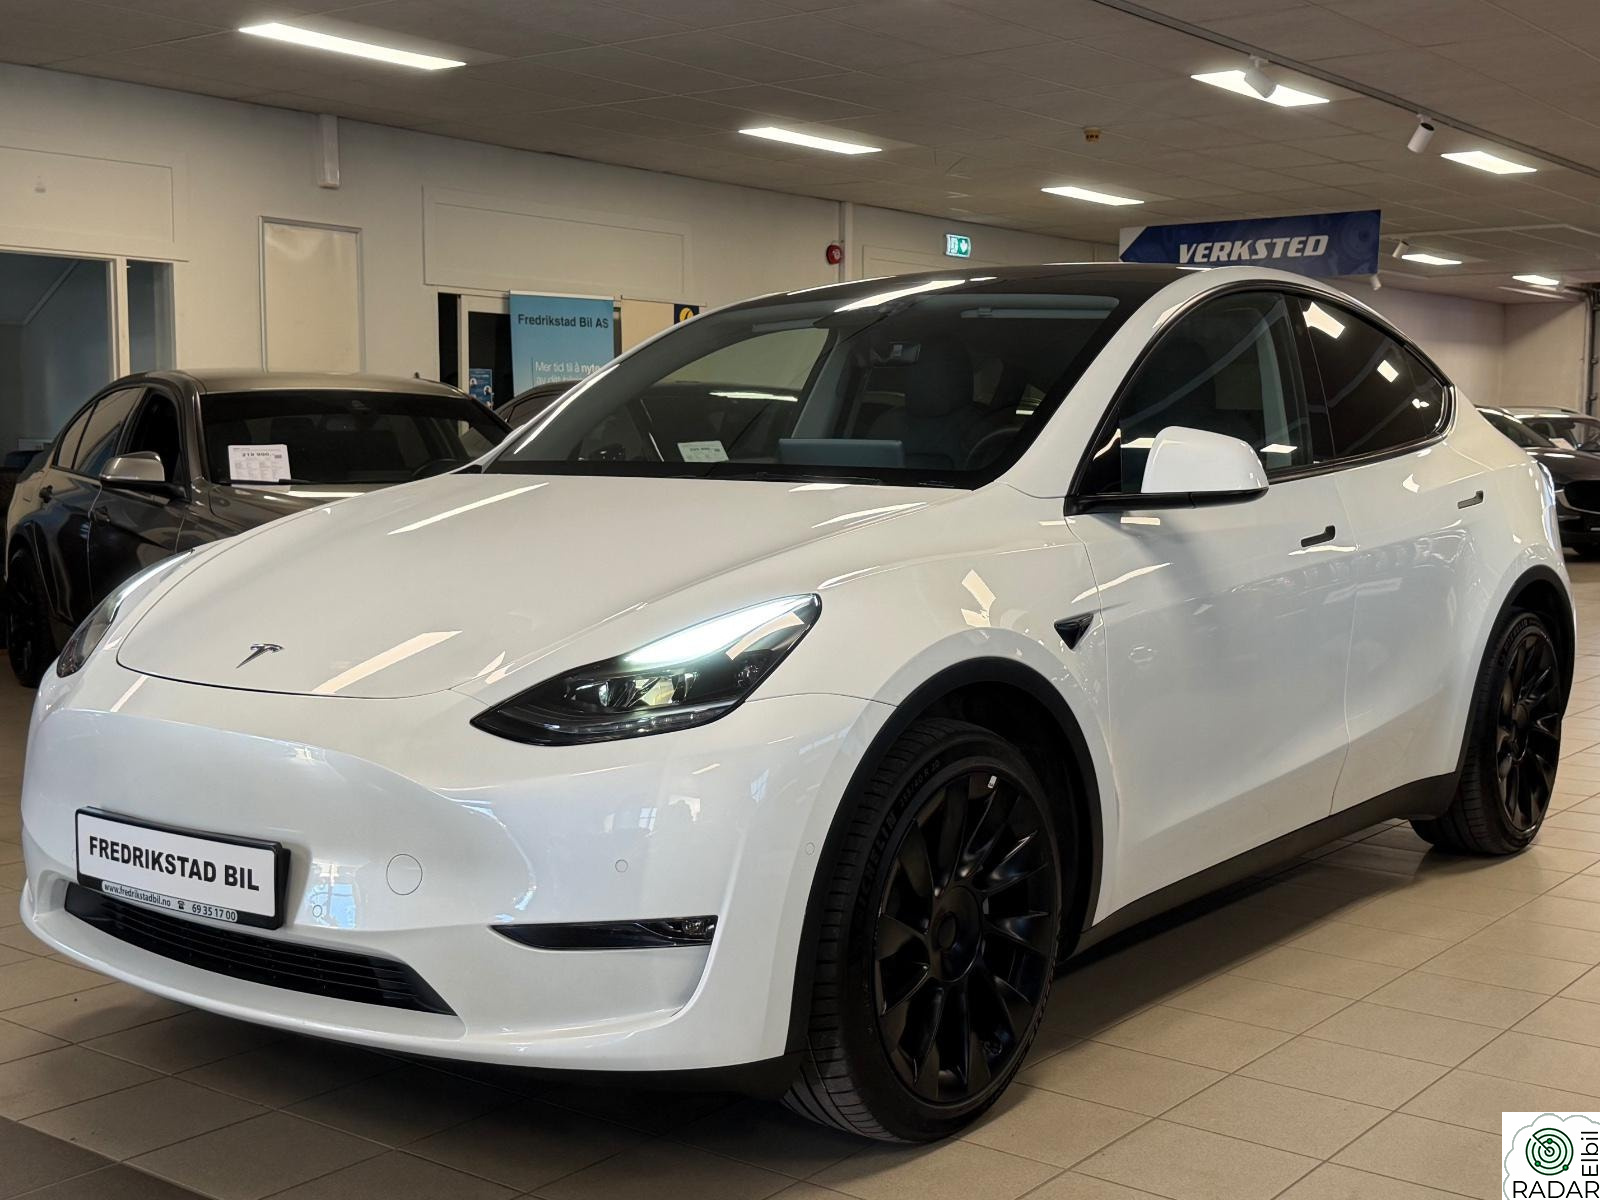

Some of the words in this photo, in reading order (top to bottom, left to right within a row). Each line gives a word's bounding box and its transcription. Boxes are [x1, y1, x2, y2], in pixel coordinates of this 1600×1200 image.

[1179, 234, 1329, 264] VERKSTED
[518, 314, 576, 327] Fredrikstad
[579, 315, 593, 328] Bil
[595, 317, 609, 329] AS
[535, 361, 552, 372] Mer
[89, 835, 217, 883] FREDRIKSTAD
[224, 864, 260, 892] BIL
[104, 883, 171, 907] www.fredrikstadbil.no
[191, 903, 202, 914] 69
[202, 905, 213, 916] 35
[214, 907, 224, 918] 17
[225, 909, 236, 920] 00
